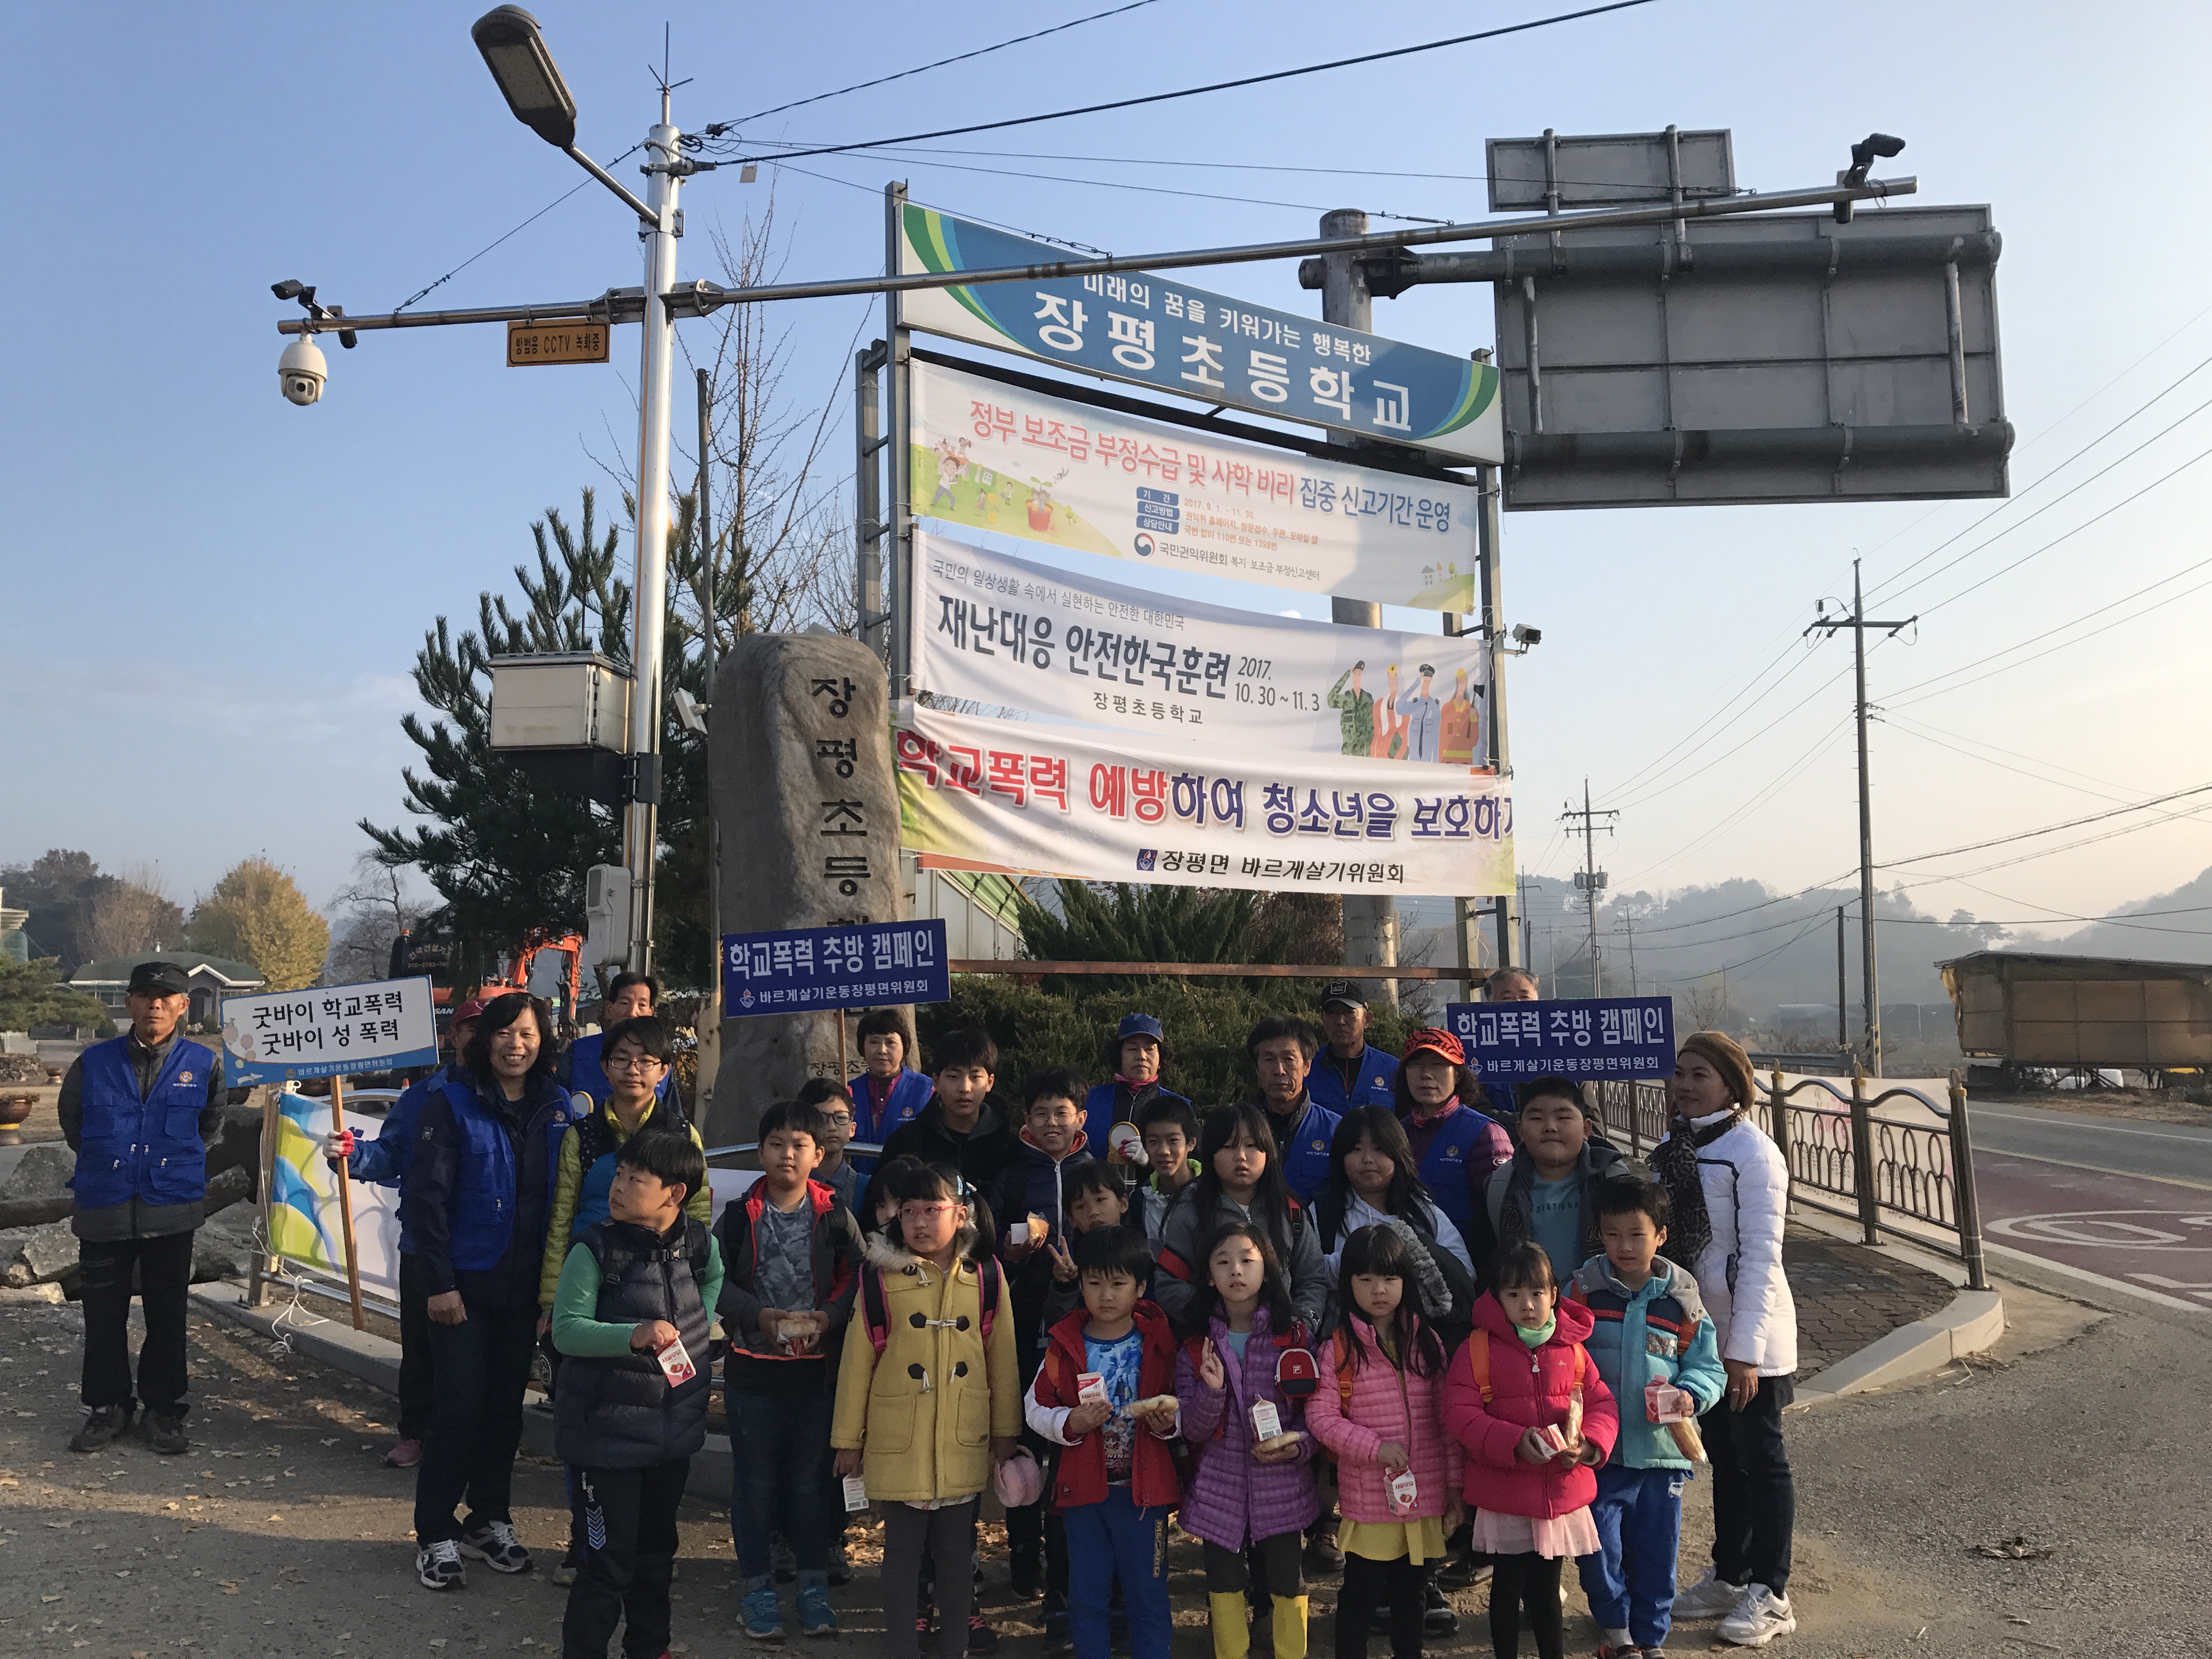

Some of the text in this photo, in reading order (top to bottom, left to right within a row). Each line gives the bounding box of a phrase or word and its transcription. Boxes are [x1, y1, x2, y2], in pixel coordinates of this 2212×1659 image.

[1084, 274, 1370, 364] 미래의 꿈을 키워가는 행복한
[516, 336, 538, 355] 방범용
[544, 335, 571, 354] CCTV
[970, 400, 1450, 533] 정부 보조금 부정수급 및 사학 비리 집중 신고기간 운영
[1143, 517, 1172, 532] 상담안내
[1144, 503, 1173, 518] 신고방법
[1186, 511, 1206, 524] 권익위
[1184, 525, 1278, 551] 국번 없이 110번 또는 1398번
[1160, 542, 1227, 566] 국민권익위원회
[1276, 564, 1320, 581] 부정신고센터
[933, 559, 1184, 632] 국민의 일상생활 속에서 실현하는 안전한 대한민국
[938, 595, 1231, 699] 재난대응 안전한국훈련
[1237, 656, 1272, 682] 2017.
[1093, 691, 1204, 725] 장평초등학교
[811, 677, 871, 927] 장평초등
[1089, 763, 1244, 828] 예방하여
[1263, 782, 1397, 838] 청소년을
[1162, 851, 1404, 883] 장평면 바르게살기위원회
[730, 929, 934, 980] 학교폭력 추방 캠페인
[252, 991, 403, 1029] 굿바이 학교폭력
[760, 979, 929, 1004] 바르게살기운동장평면위원회
[262, 1019, 398, 1056] 굿바이 성 폭력
[1457, 1007, 1664, 1048] 학교폭력 추방 캠페인
[1487, 1056, 1659, 1074] 바르게살기운동장평면위원회
